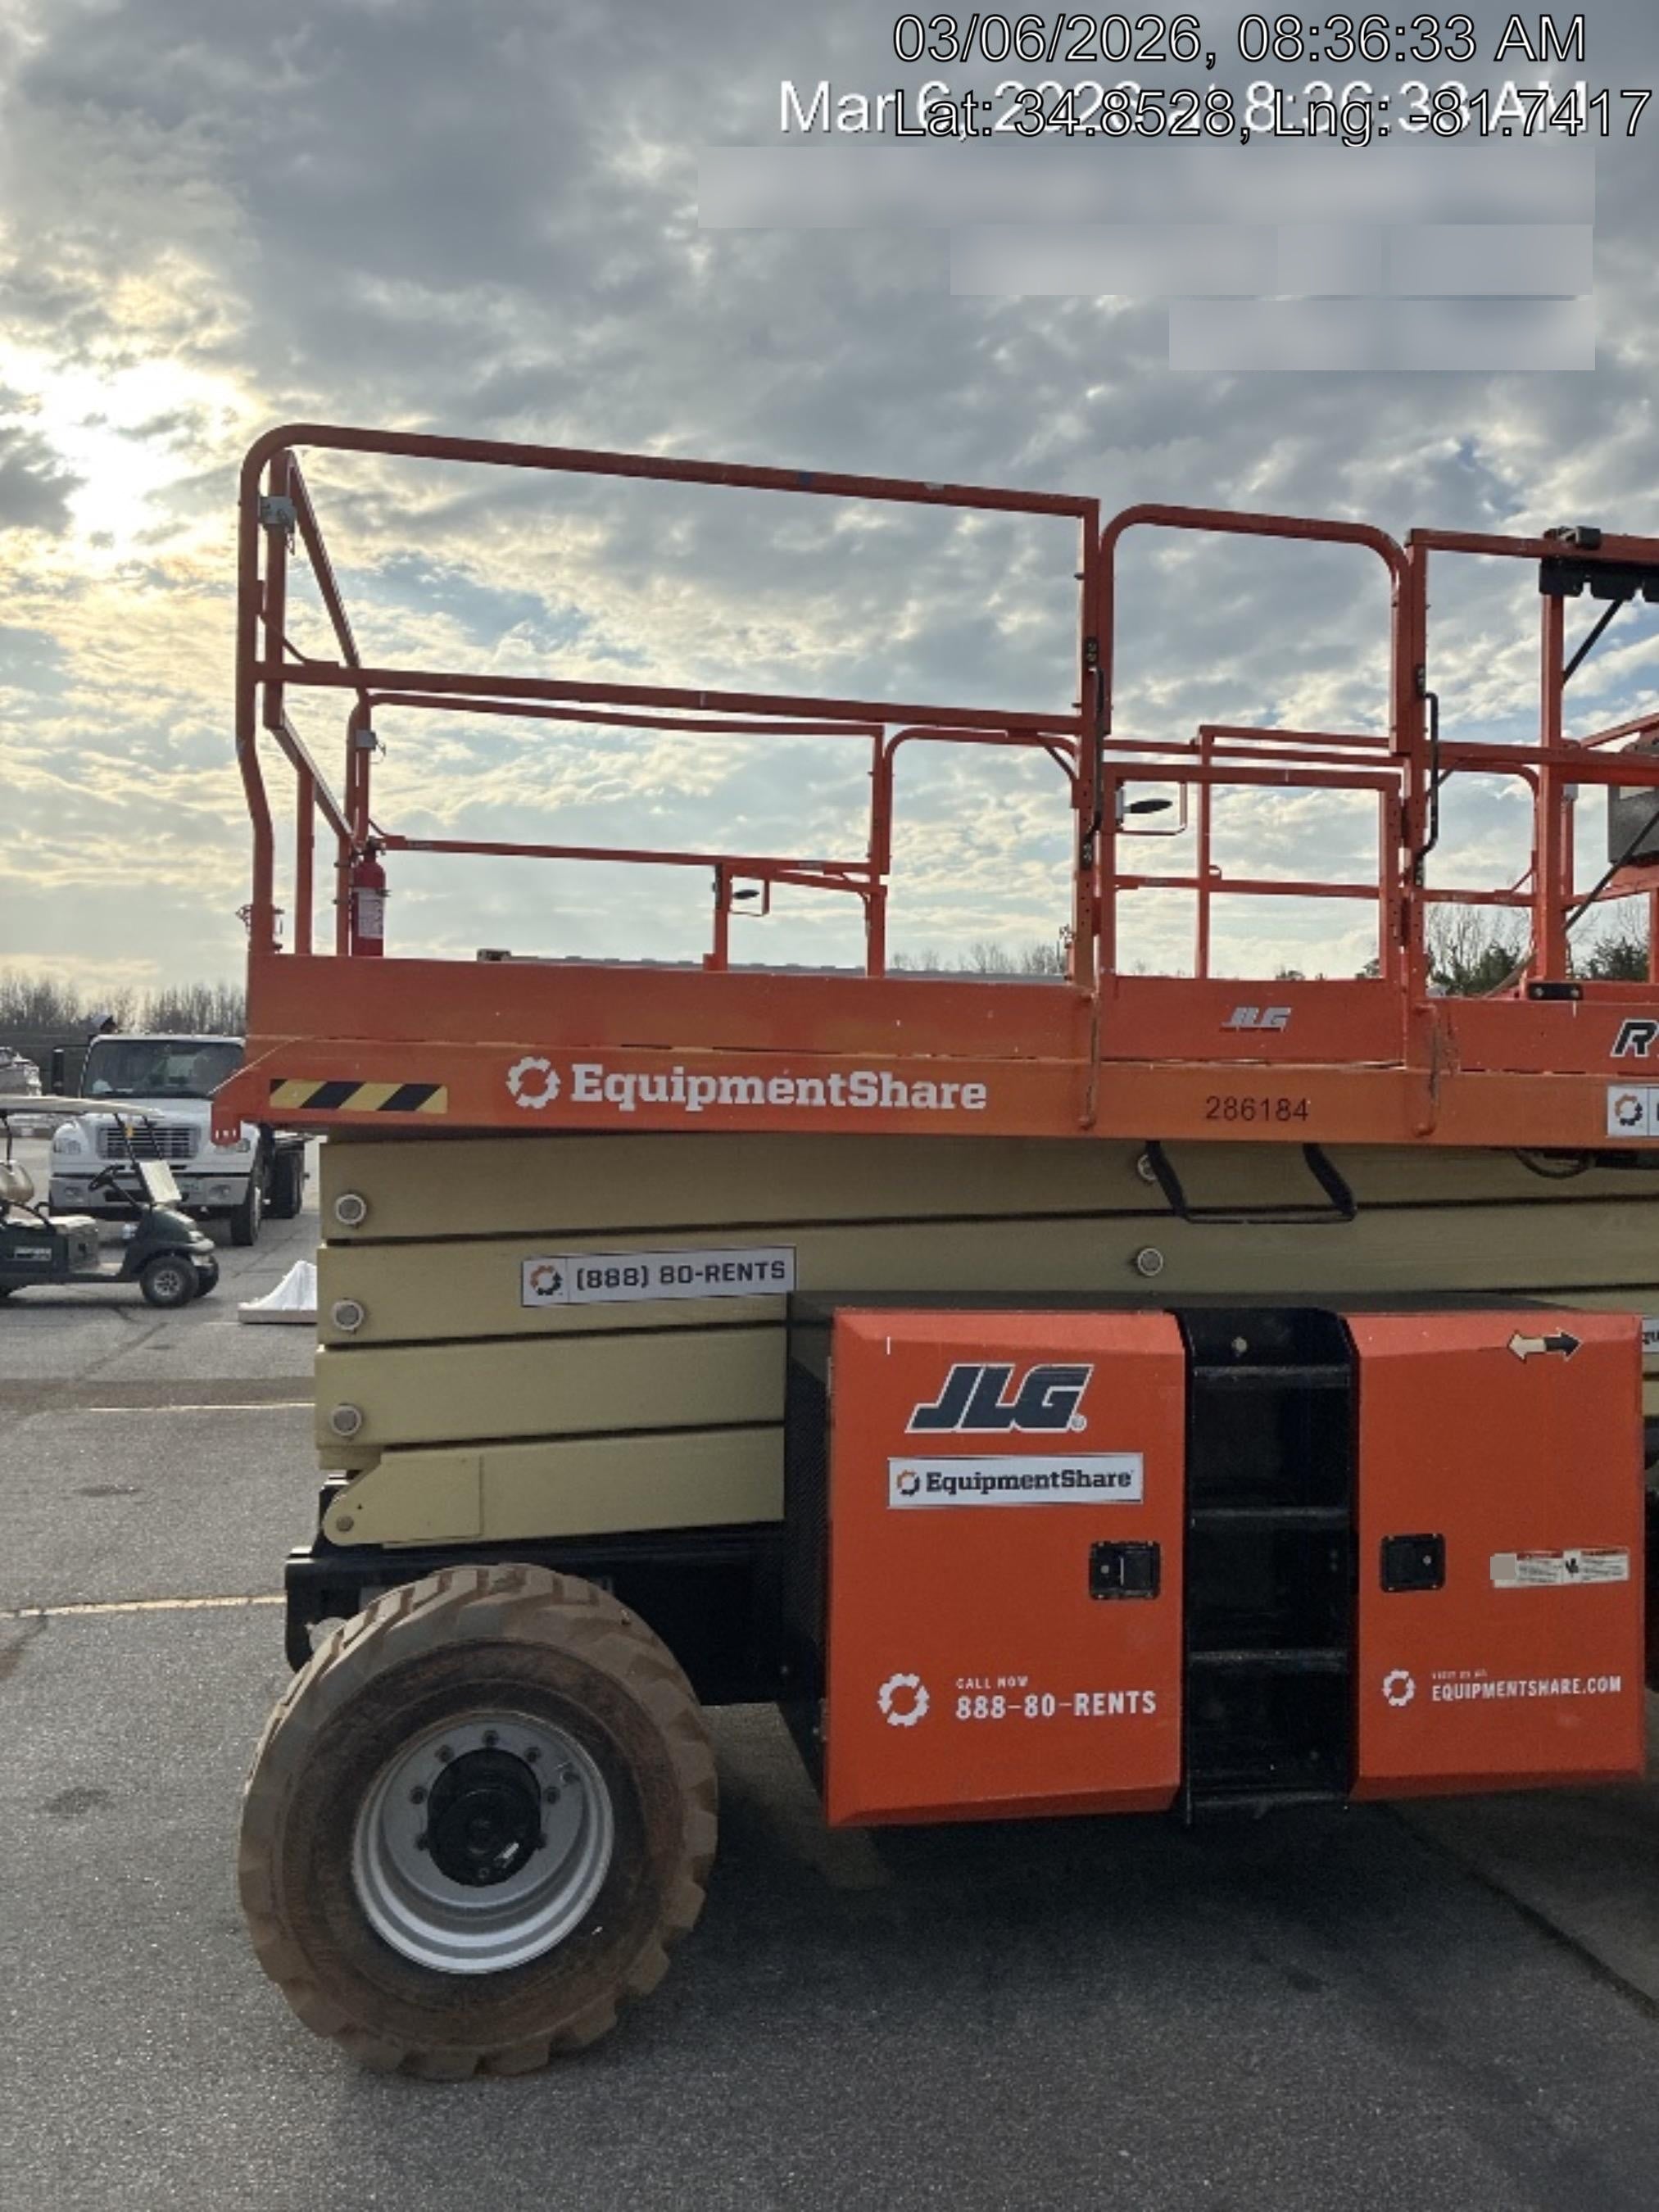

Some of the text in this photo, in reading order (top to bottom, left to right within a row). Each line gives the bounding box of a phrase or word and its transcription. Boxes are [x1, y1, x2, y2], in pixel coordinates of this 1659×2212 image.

[1610, 1019, 1659, 1058] R
[571, 1064, 987, 1112] EquipmentShare
[1206, 1095, 1308, 1121] 286184
[577, 1259, 786, 1291] (888) 80-RENTS
[904, 1363, 1095, 1434] JLG
[926, 1469, 1131, 1494] EquipmentShare
[956, 1675, 1029, 1690] CALL NOW
[1431, 1675, 1621, 1702] EQUIPMENTSHARE.COM
[955, 1689, 1157, 1720] 888-80-RENTS
